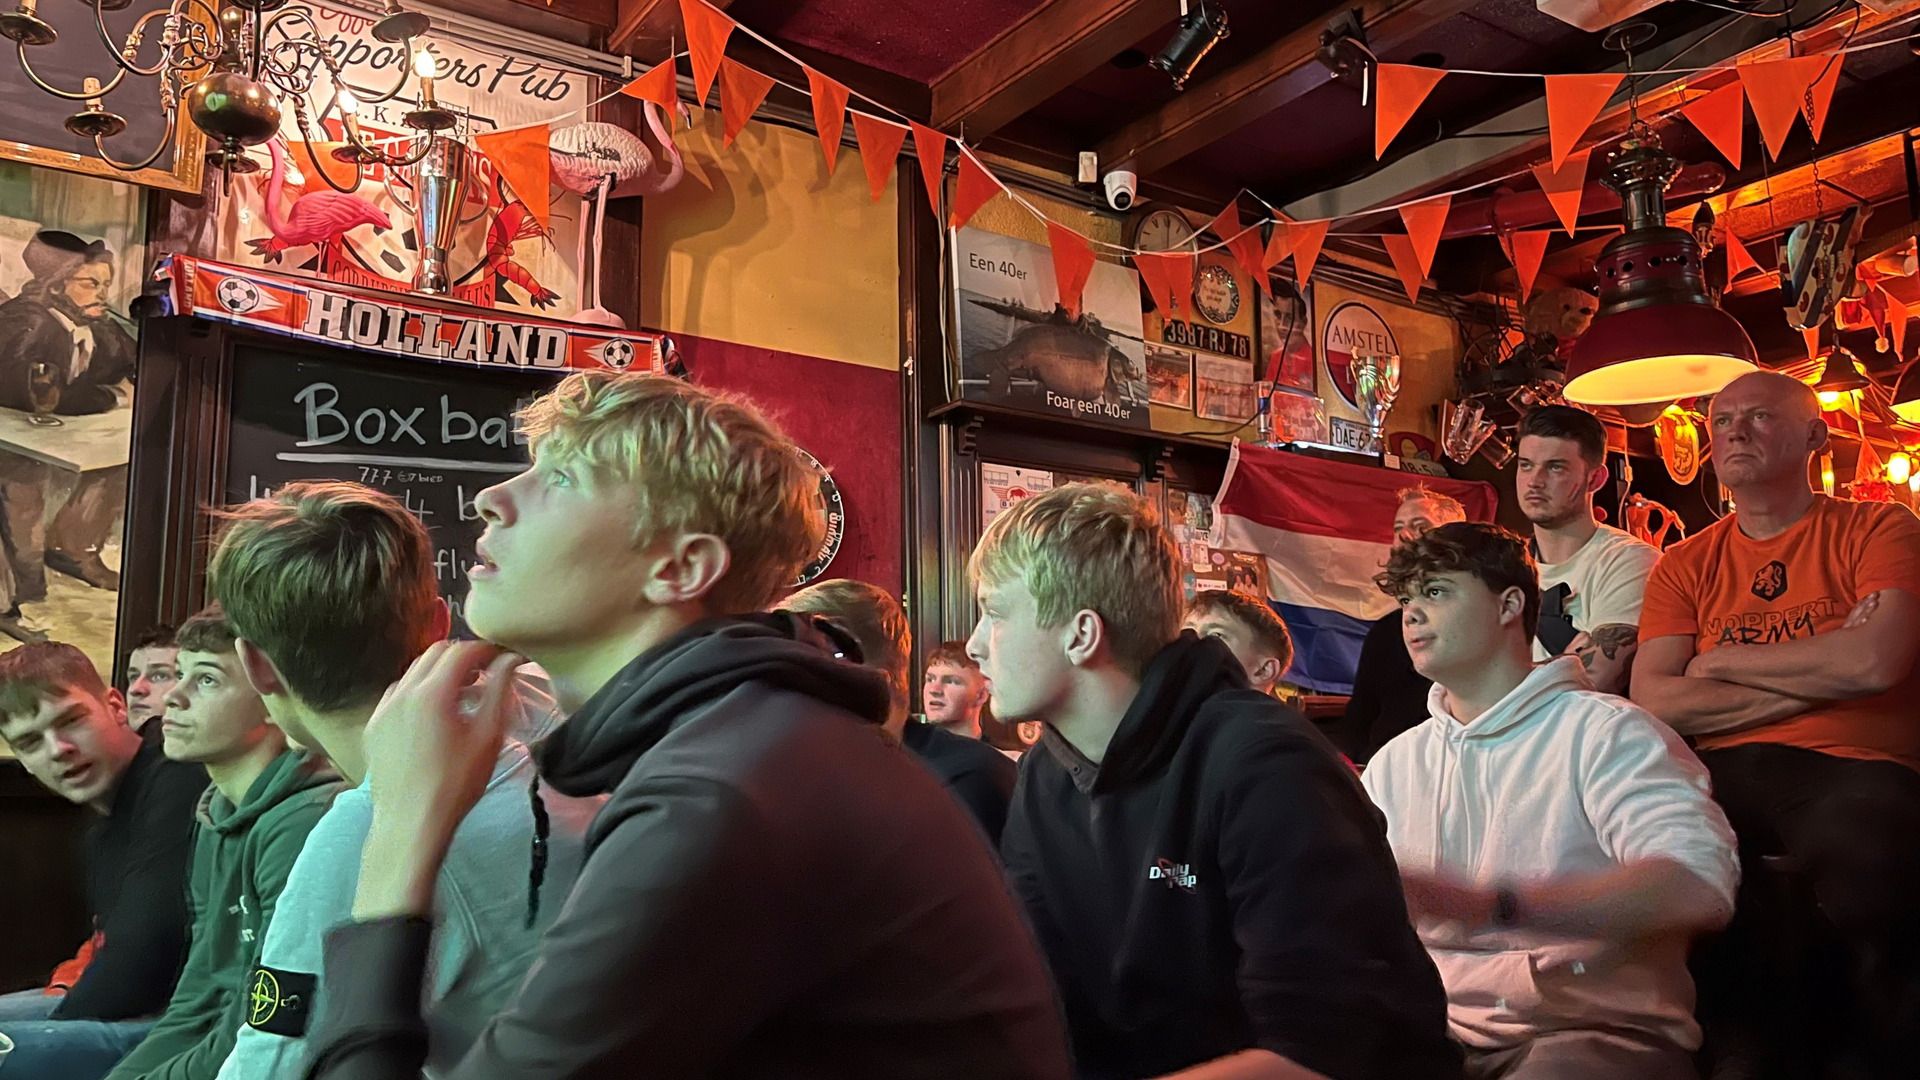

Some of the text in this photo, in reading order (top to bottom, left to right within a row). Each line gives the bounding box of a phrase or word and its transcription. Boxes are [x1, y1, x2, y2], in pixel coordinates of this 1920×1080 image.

[487, 54, 571, 101] Pub
[969, 252, 1027, 280] Een 40er
[303, 289, 568, 368] HOLLAND
[1167, 321, 1247, 357] 3987 RJ 78
[1332, 325, 1393, 354] AMSTEL
[294, 382, 426, 447] Box
[1046, 390, 1131, 419] Foar een 40er
[1703, 596, 1839, 637] NOPPERT
[1715, 611, 1815, 646] ARMY
